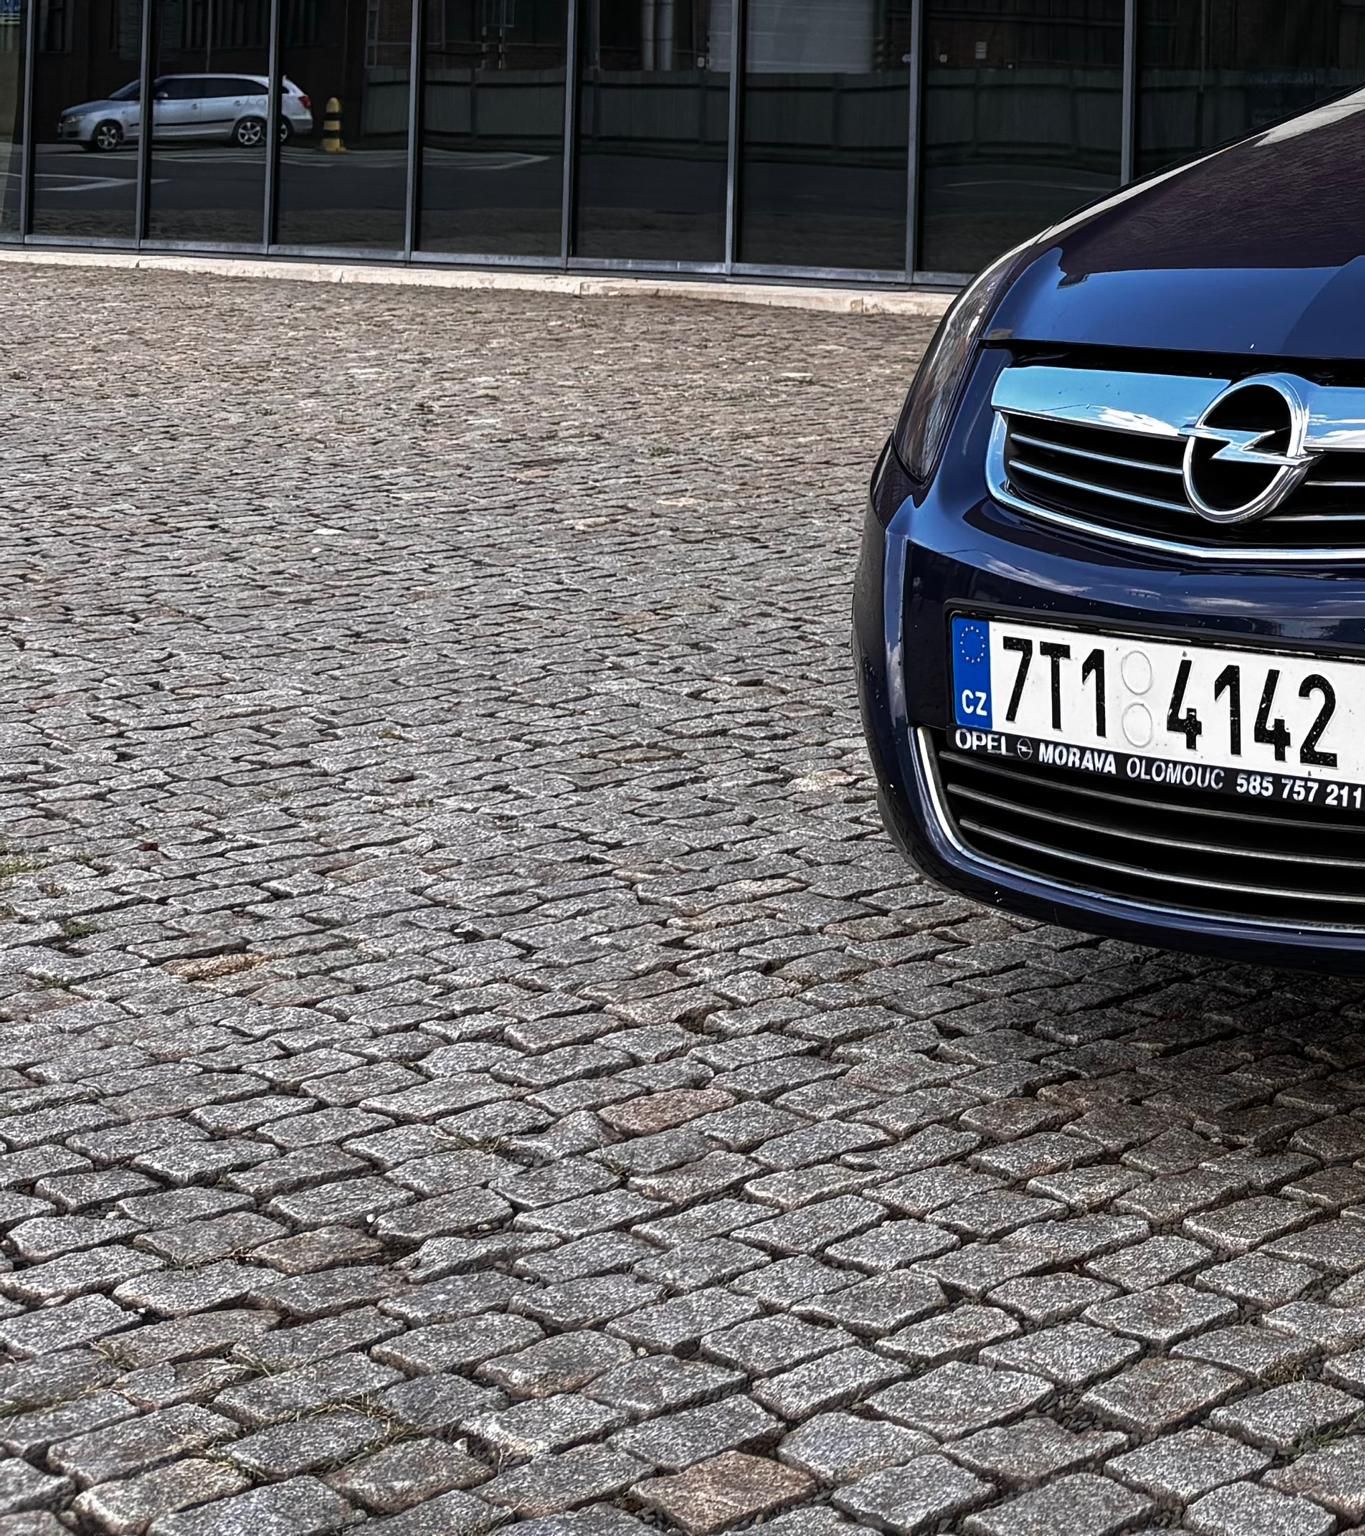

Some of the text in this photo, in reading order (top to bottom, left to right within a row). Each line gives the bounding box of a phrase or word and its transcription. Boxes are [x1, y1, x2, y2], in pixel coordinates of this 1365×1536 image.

[961, 688, 988, 716] CZ
[1002, 635, 1339, 769] 7T1 4142
[955, 728, 1362, 809] OPEL MORAVA OLOMOUC 585 757 211
